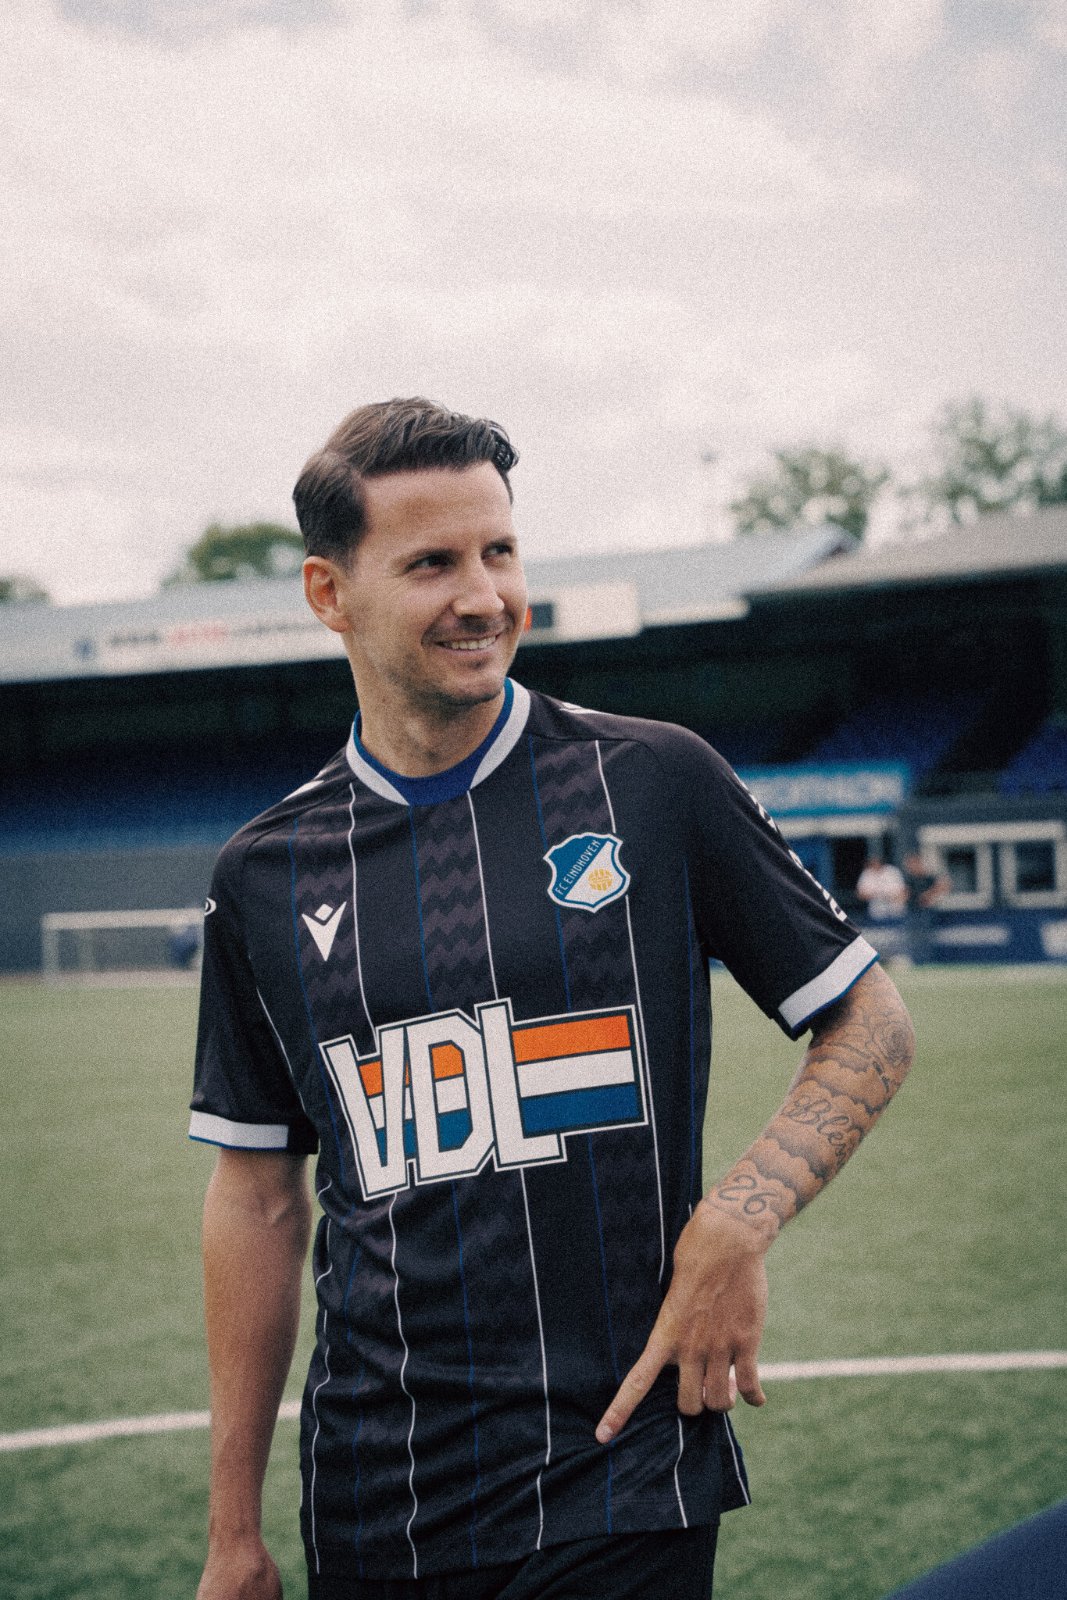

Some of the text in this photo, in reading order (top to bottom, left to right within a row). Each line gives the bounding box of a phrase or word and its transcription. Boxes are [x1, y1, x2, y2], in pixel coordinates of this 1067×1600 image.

[555, 840, 601, 895] FC EINDHOVEN
[322, 1000, 564, 1198] VDL
[718, 1174, 778, 1215] 26
